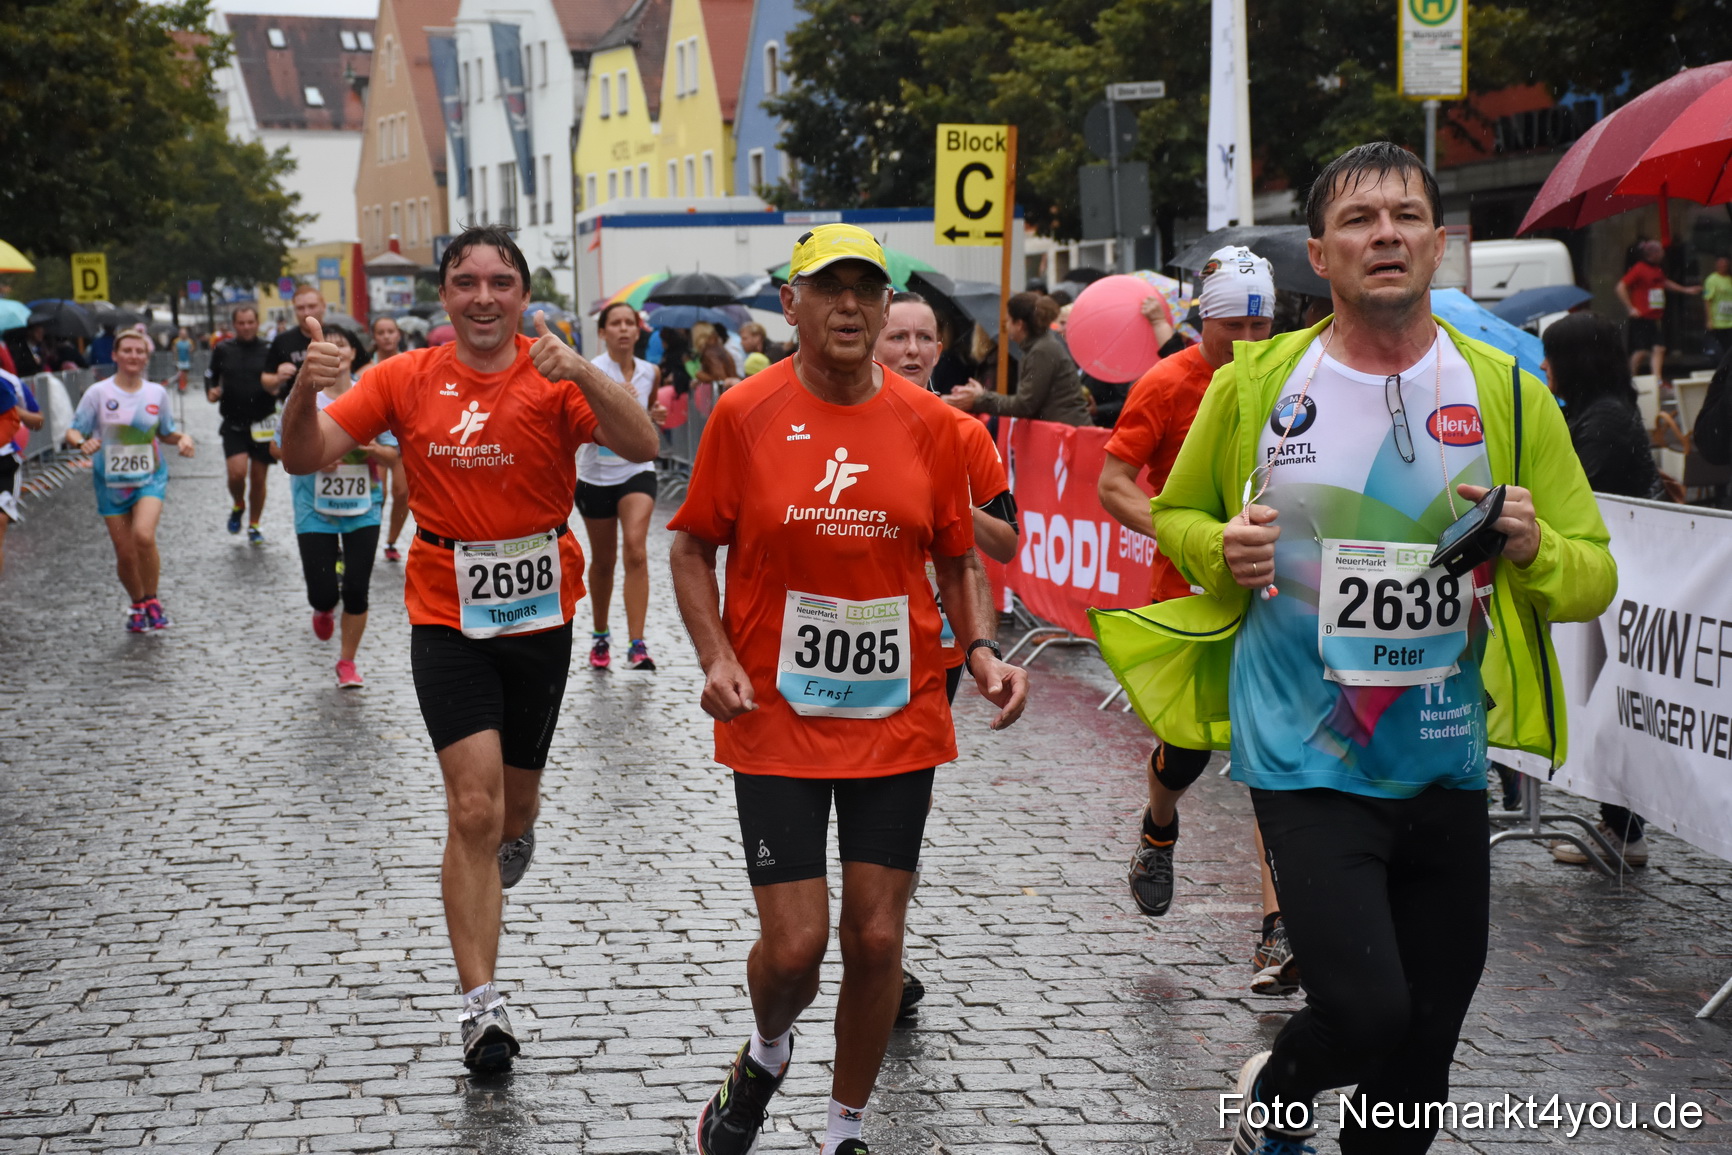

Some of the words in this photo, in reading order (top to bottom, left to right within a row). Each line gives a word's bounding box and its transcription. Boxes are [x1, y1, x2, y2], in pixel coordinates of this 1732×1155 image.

[946, 130, 1007, 152] Block
[955, 161, 994, 220] C
[82, 268, 99, 291] D
[1275, 395, 1314, 412] BMW
[786, 433, 811, 442] erima
[427, 442, 501, 458] funrunners
[1267, 443, 1317, 459] PARTL
[111, 455, 150, 473] 2266
[451, 453, 515, 469] neumarkt
[321, 476, 367, 496] 2378
[783, 505, 887, 525] funrunners
[815, 523, 901, 539] neumarkt
[1335, 557, 1387, 567] NeuerMarkt
[468, 555, 554, 600] 2698
[796, 606, 838, 620] NeuerMarkt
[845, 602, 900, 621] BOCK
[1336, 575, 1462, 631] 2638
[489, 605, 538, 623] Thomas
[1325, 625, 1332, 635] D
[1618, 599, 1692, 680] BMW
[794, 624, 900, 675] 3085
[1373, 645, 1425, 666] Peter
[803, 680, 854, 701] Ernst
[1421, 681, 1452, 705] 17.
[1617, 685, 1694, 750] WENIGER
[1420, 720, 1472, 740] Stadtlauf
